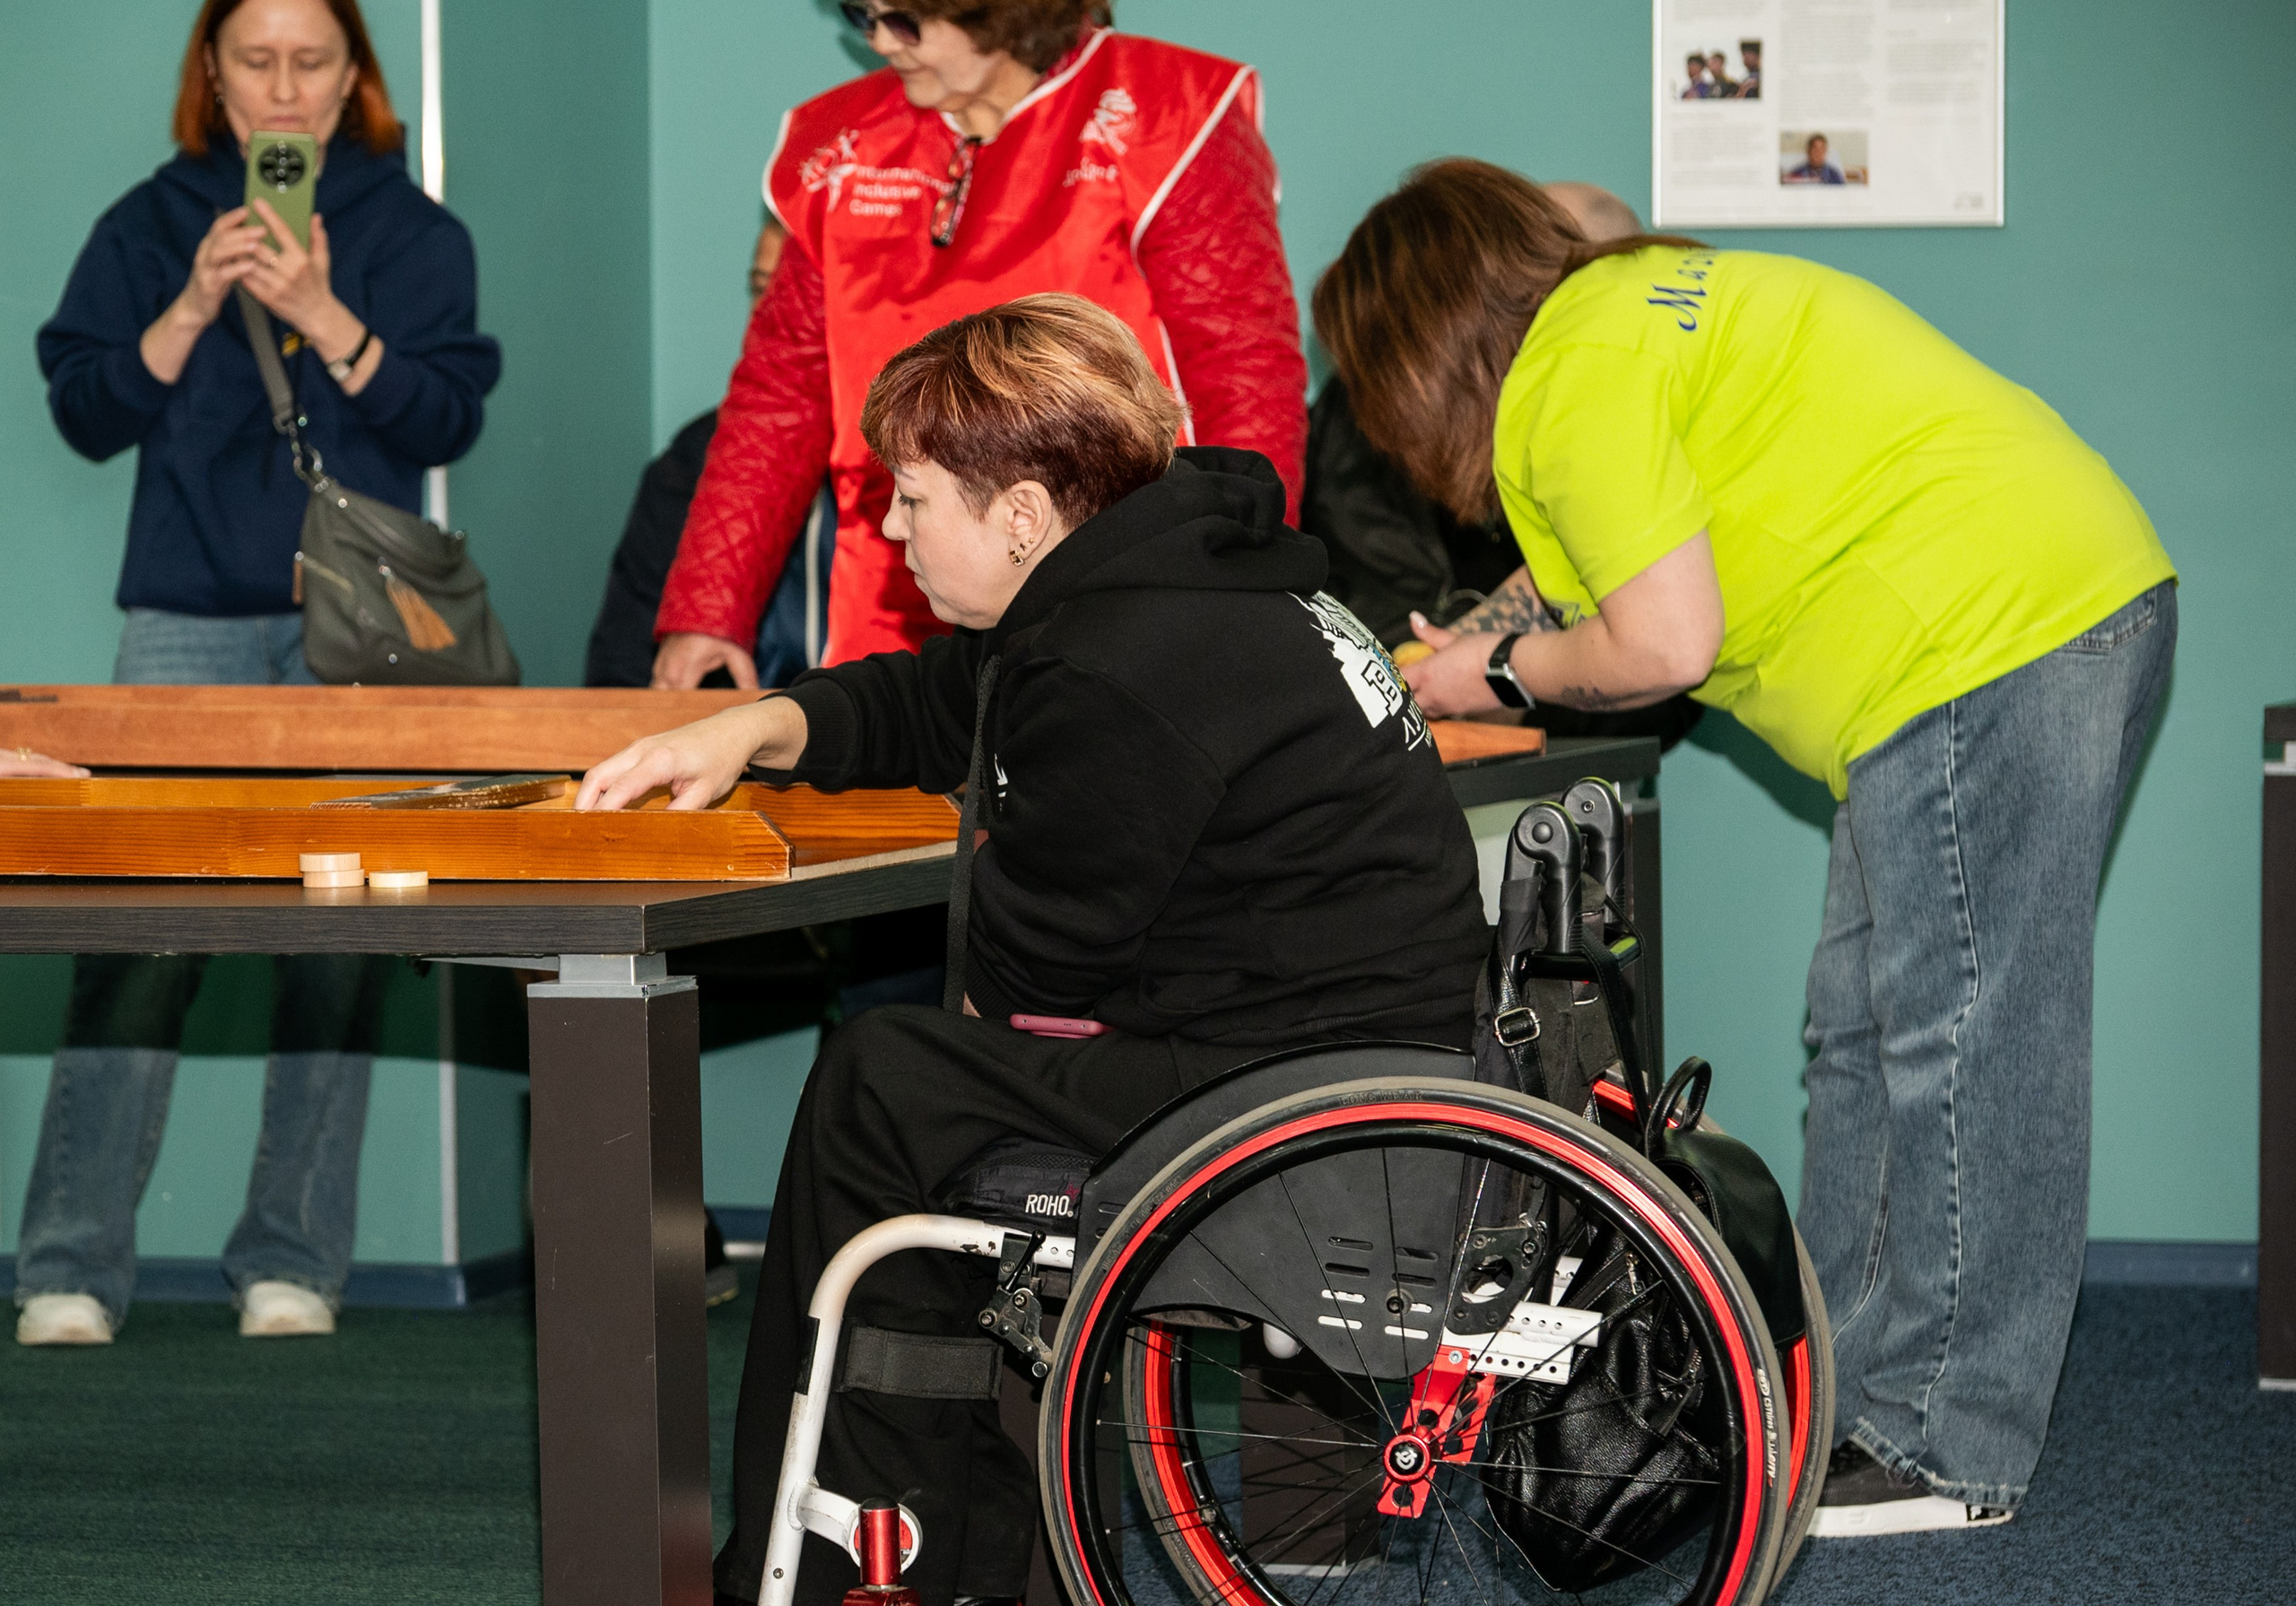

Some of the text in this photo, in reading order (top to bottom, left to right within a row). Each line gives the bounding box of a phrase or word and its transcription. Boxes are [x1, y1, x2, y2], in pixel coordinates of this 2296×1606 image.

[849, 199, 902, 217] Games
[1338, 1089, 1422, 1106] LONG WEAR
[1025, 1194, 1070, 1217] ROHO
